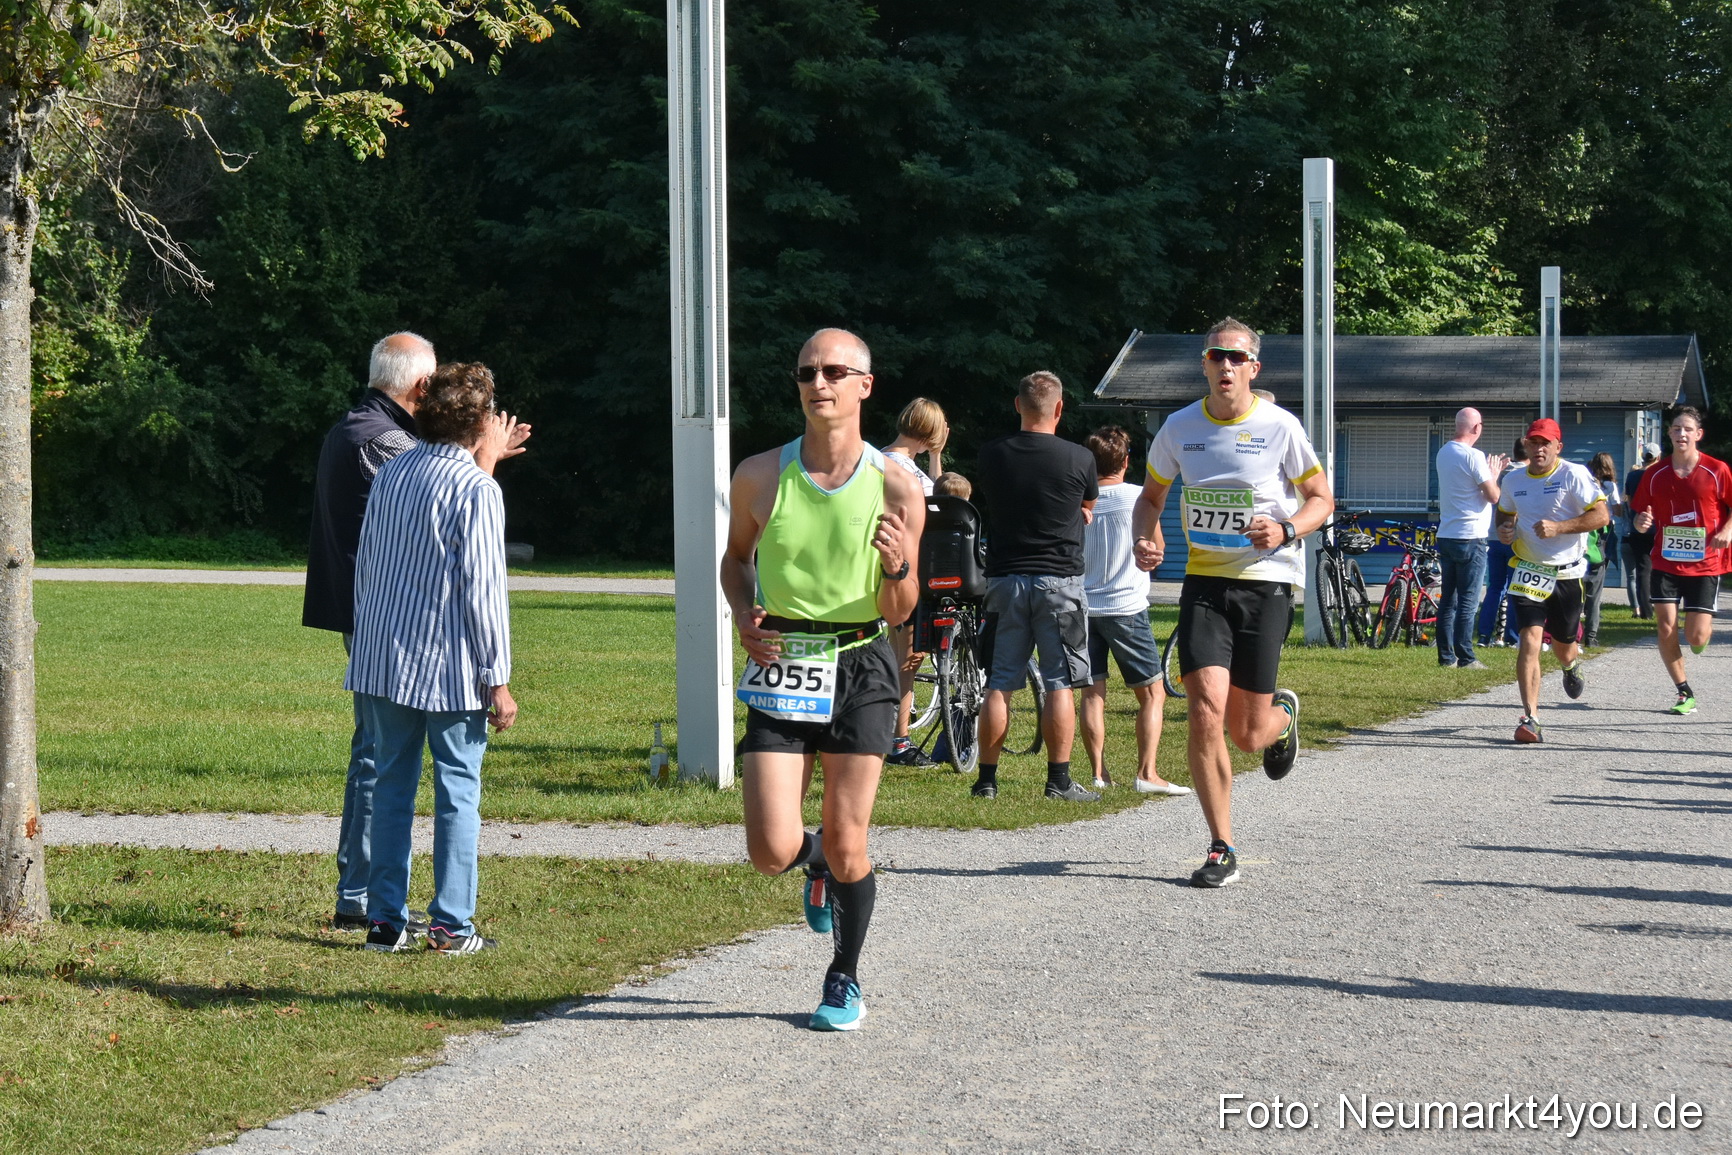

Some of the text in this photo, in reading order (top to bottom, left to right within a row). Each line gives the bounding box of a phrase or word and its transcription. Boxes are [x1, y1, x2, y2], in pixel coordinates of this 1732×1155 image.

[1237, 433, 1250, 442] 20
[1189, 490, 1247, 506] BOCK
[1192, 509, 1245, 531] 2775
[1667, 527, 1699, 536] BOCK
[1668, 538, 1699, 550] 2562
[1518, 560, 1555, 574] BOCK
[1517, 570, 1550, 588] 1097
[1512, 585, 1547, 599] CHRISTIAN
[748, 662, 823, 692] 2055
[748, 695, 817, 711] ANDREAS
